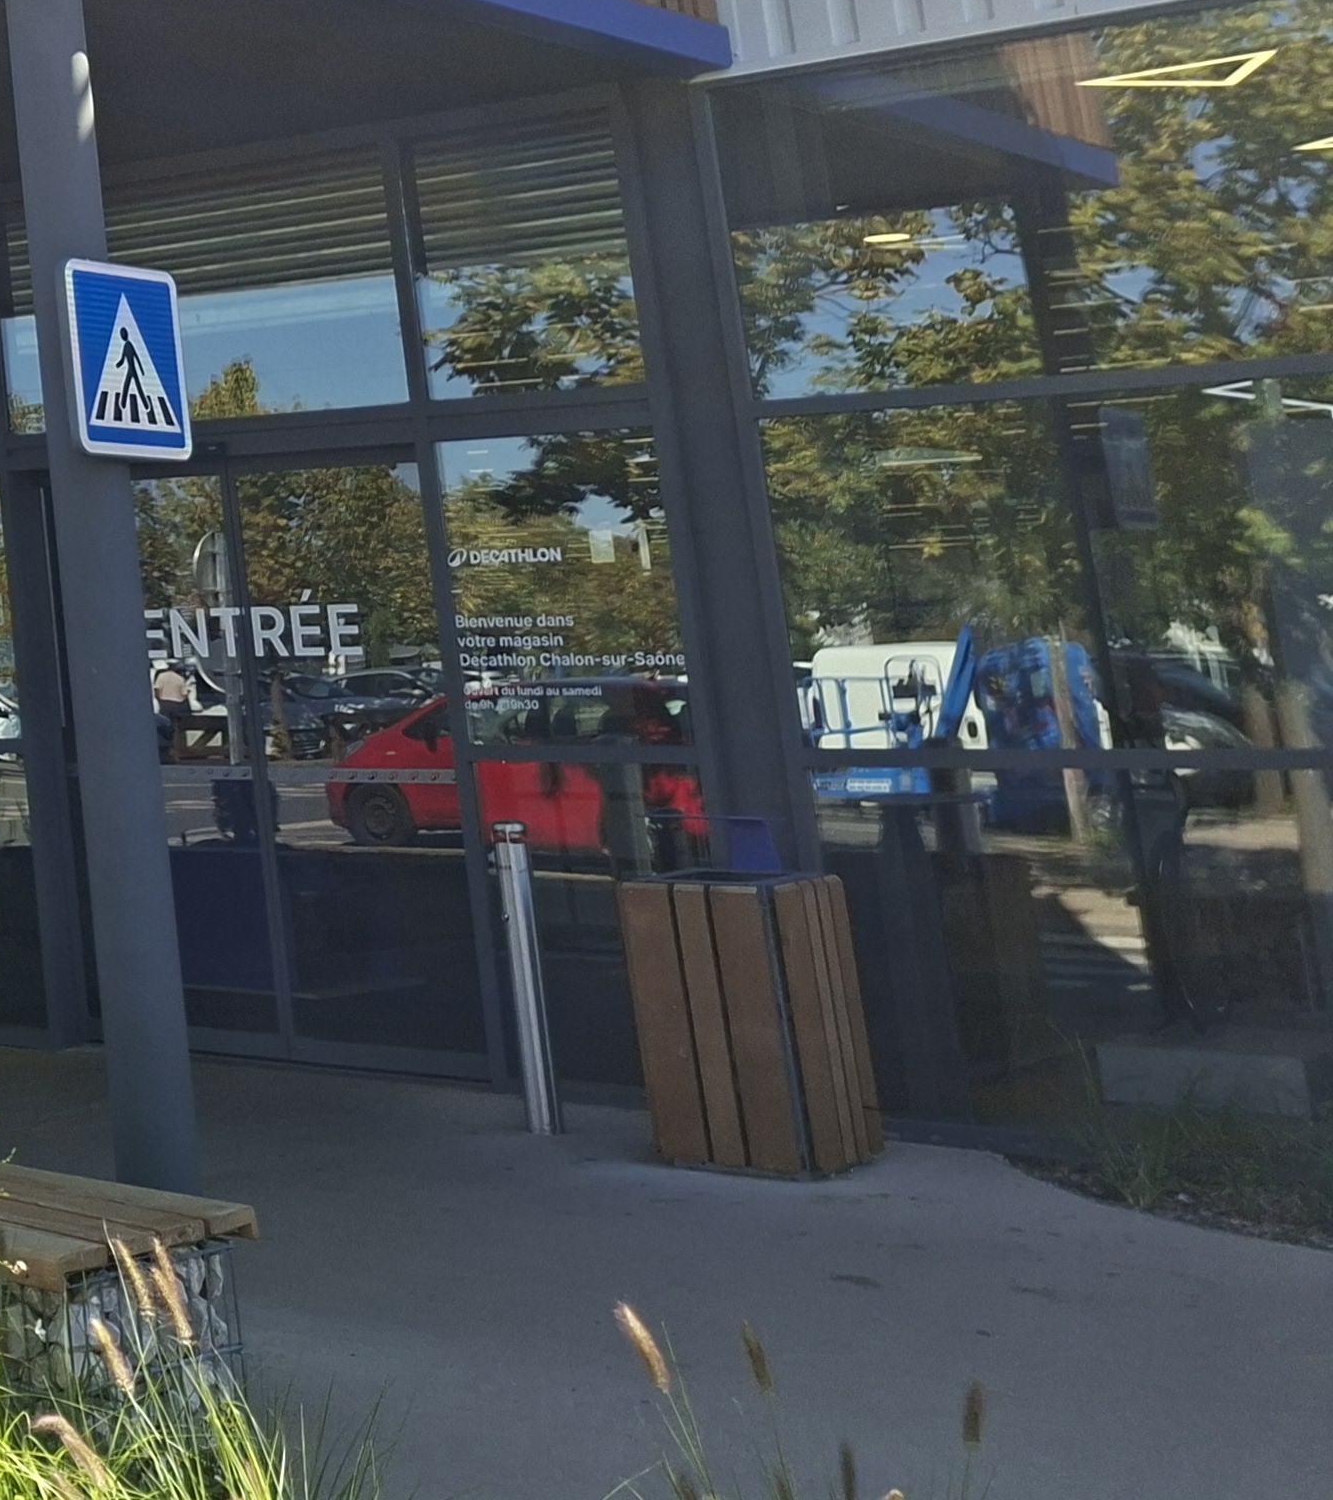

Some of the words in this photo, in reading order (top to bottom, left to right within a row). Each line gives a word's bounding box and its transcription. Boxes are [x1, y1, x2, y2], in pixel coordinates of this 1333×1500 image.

[469, 548, 562, 565] DECATHLON
[144, 589, 363, 659] ENTRÉE
[455, 615, 532, 628] Bienvenue
[536, 614, 574, 627] dans
[457, 635, 496, 647] votre
[499, 633, 564, 650] magasin
[459, 653, 536, 667] Decathlon
[539, 651, 685, 667] Chalon-sur-Saône
[501, 685, 515, 696] du
[516, 685, 544, 696] lundi
[546, 687, 559, 696] au
[562, 685, 602, 696] samedi
